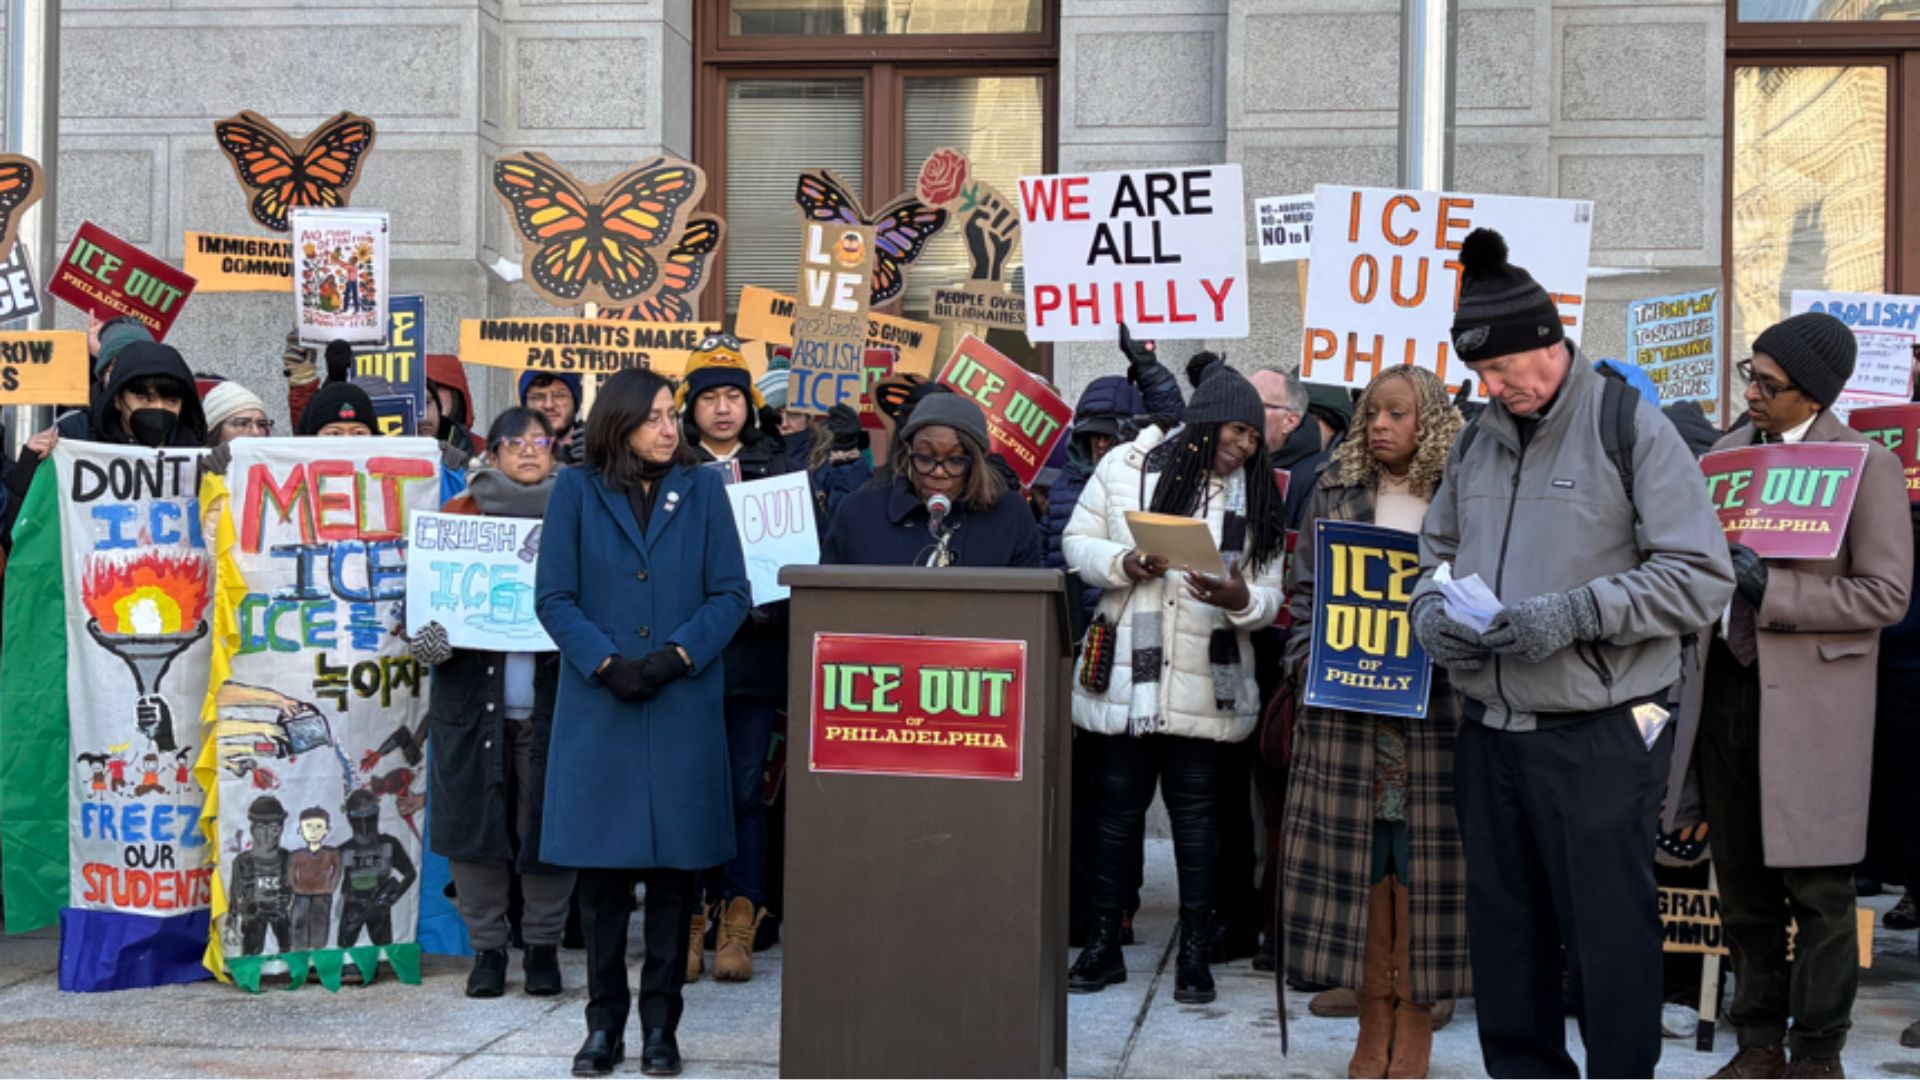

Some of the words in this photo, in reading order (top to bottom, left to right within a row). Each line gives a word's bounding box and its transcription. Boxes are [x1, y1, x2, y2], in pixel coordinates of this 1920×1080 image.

[1020, 177, 1090, 222] WE
[1110, 170, 1213, 218] ARE
[1087, 220, 1181, 266] ALL
[1262, 227, 1286, 246] NO
[1289, 231, 1302, 244] to
[1348, 191, 1474, 250] ICE
[69, 237, 124, 285] ICE
[124, 267, 184, 315] OUT
[936, 289, 985, 305] PEOPLE
[1349, 253, 1466, 314] OUT
[62, 271, 162, 331] PHILADELPHIA
[935, 303, 1025, 325] BILLIONAIRES
[1034, 276, 1236, 327] PHILLY
[480, 321, 630, 347] IMMIGRANTS
[634, 328, 697, 349] MAKE
[791, 338, 862, 372] ABOLISH
[526, 347, 555, 369] PA
[559, 348, 651, 372] STRONG
[789, 368, 861, 412] ICE
[947, 354, 1006, 409] ICE
[1003, 390, 1060, 447] OUT
[72, 450, 191, 502] DON'T
[1761, 467, 1852, 508] OUT
[241, 456, 434, 554] MELT
[743, 486, 805, 545] OUT
[415, 515, 517, 552] CRUSH
[270, 539, 408, 603] ICE
[430, 560, 520, 612] ICE
[1329, 543, 1420, 602] ICE
[1325, 603, 1412, 660] OUT
[312, 652, 429, 713] 녹이자
[1324, 667, 1415, 692] PHILLY
[1358, 659, 1383, 672] OF
[822, 664, 904, 713] ICE
[919, 667, 1015, 717] OUT
[825, 726, 1008, 749] PHILADELPHIA
[905, 716, 925, 727] OF
[81, 802, 206, 848] FREEZ
[124, 843, 175, 868] OUR
[82, 862, 212, 909] STUDENTS
